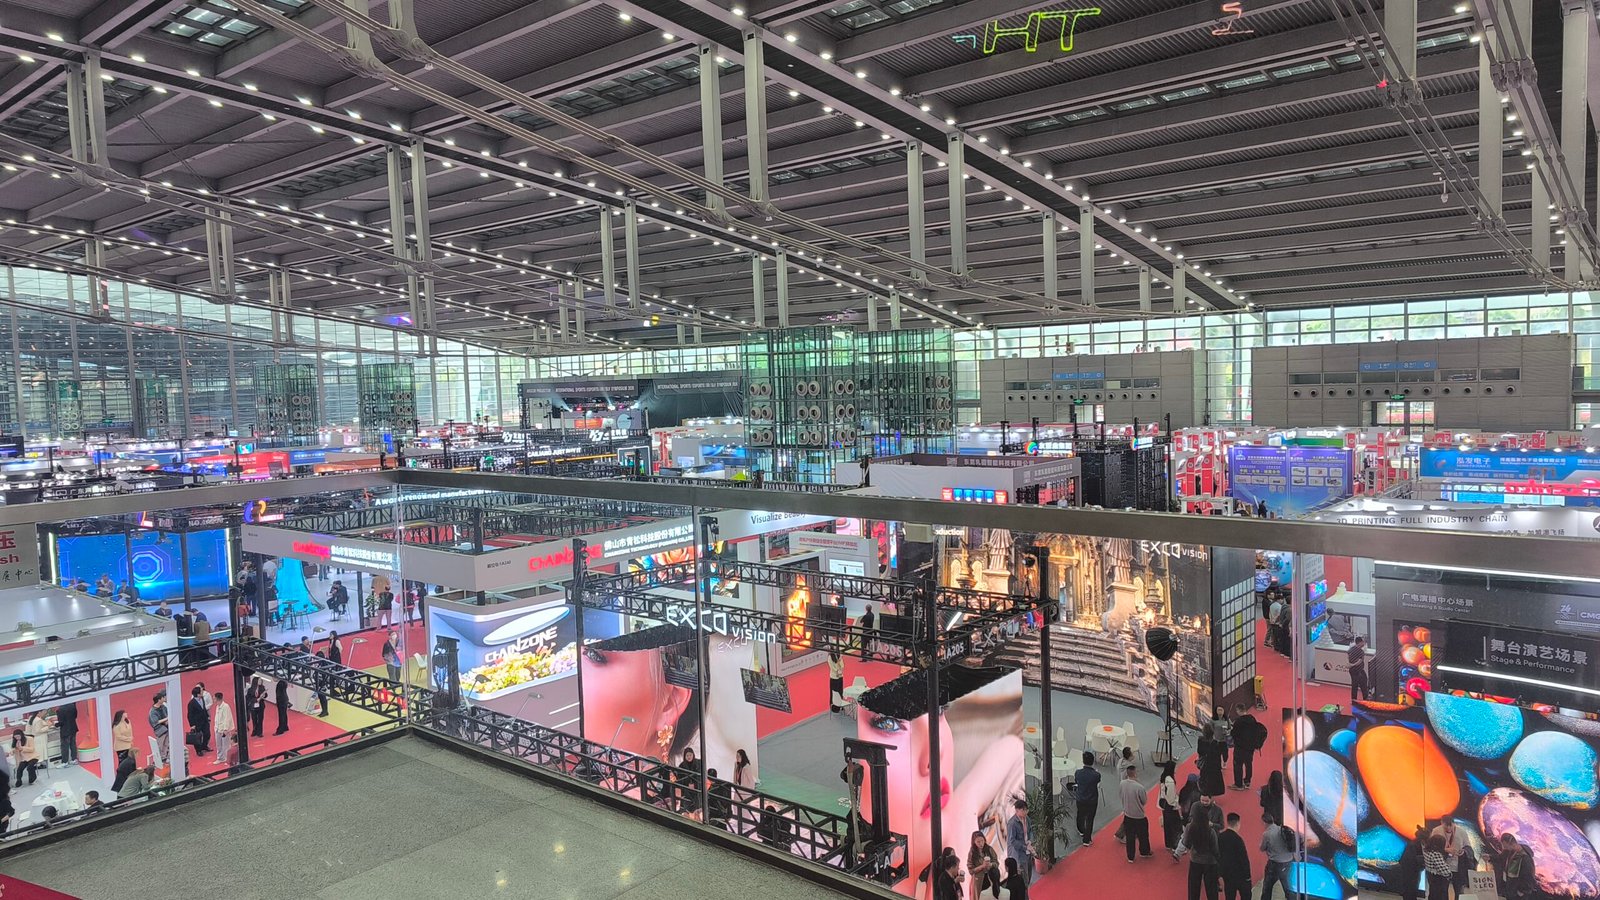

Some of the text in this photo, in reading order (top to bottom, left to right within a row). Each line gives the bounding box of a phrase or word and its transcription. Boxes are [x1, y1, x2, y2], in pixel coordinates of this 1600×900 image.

[750, 513, 783, 530] Visualize
[1352, 515, 1397, 527] PRINTING
[1400, 515, 1423, 526] FULL
[1426, 514, 1475, 526] INDUSTRY
[1479, 513, 1508, 524] CHAIN
[1140, 540, 1181, 559] EXCO
[667, 604, 728, 636] EXCO
[1490, 638, 1588, 667] 舞台演艺场景
[1490, 655, 1514, 667] Stage
[1523, 660, 1576, 675] Performance
